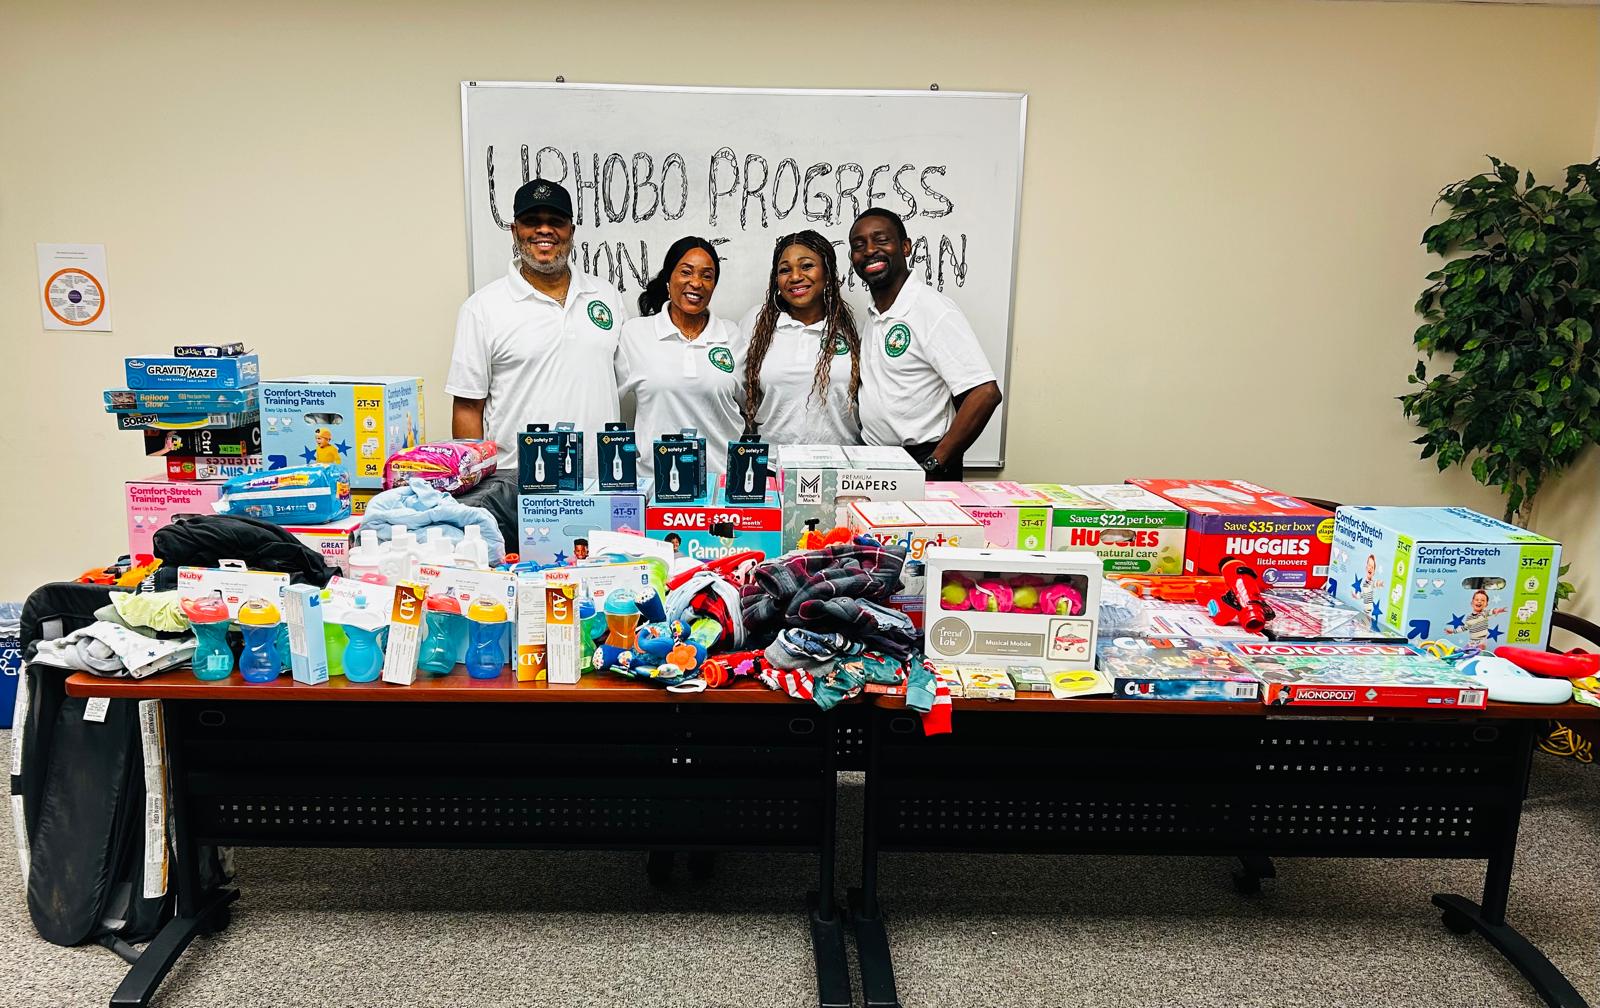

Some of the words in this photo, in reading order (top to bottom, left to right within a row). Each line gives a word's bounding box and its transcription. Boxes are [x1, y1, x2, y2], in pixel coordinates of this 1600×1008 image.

[709, 146, 954, 230] PROGRESS
[148, 366, 188, 376] GRAVITY
[188, 369, 217, 378] MAZE
[264, 388, 336, 398] Comfort-Stretch
[264, 398, 298, 406] Training
[357, 400, 380, 408] 2T-3T
[124, 415, 158, 428] SORRY!
[202, 430, 212, 454] Ctrl
[842, 480, 897, 490] DIAPERS
[130, 487, 202, 496] Comfort-Stretch
[131, 496, 165, 505] Training
[167, 496, 190, 504] Pants
[522, 498, 594, 507] Comfort-Stretch
[523, 507, 557, 516] Training
[663, 513, 705, 526] SAVE
[1100, 514, 1126, 526] $22
[1127, 517, 1144, 525] per
[1336, 510, 1383, 540] Comfort-Stretch
[1224, 522, 1247, 531] Save
[1248, 521, 1274, 533] $35
[1275, 524, 1291, 532] per
[1293, 522, 1311, 531] box
[1071, 528, 1159, 547] HUES
[1335, 521, 1356, 542] Training
[1357, 534, 1373, 548] Pants
[1226, 538, 1310, 555] HUGGIES
[1418, 547, 1500, 556] Comfort-Stretch
[1418, 556, 1457, 566] Training
[1459, 557, 1486, 565] Pants
[1522, 558, 1549, 566] 3T-4T
[938, 627, 964, 638] Trend
[939, 637, 956, 646] Lab
[1113, 637, 1188, 650] CLUE
[1246, 645, 1406, 656] MONOPOLY
[1125, 682, 1154, 695] CLUE
[1297, 691, 1354, 700] MONOPOLY
